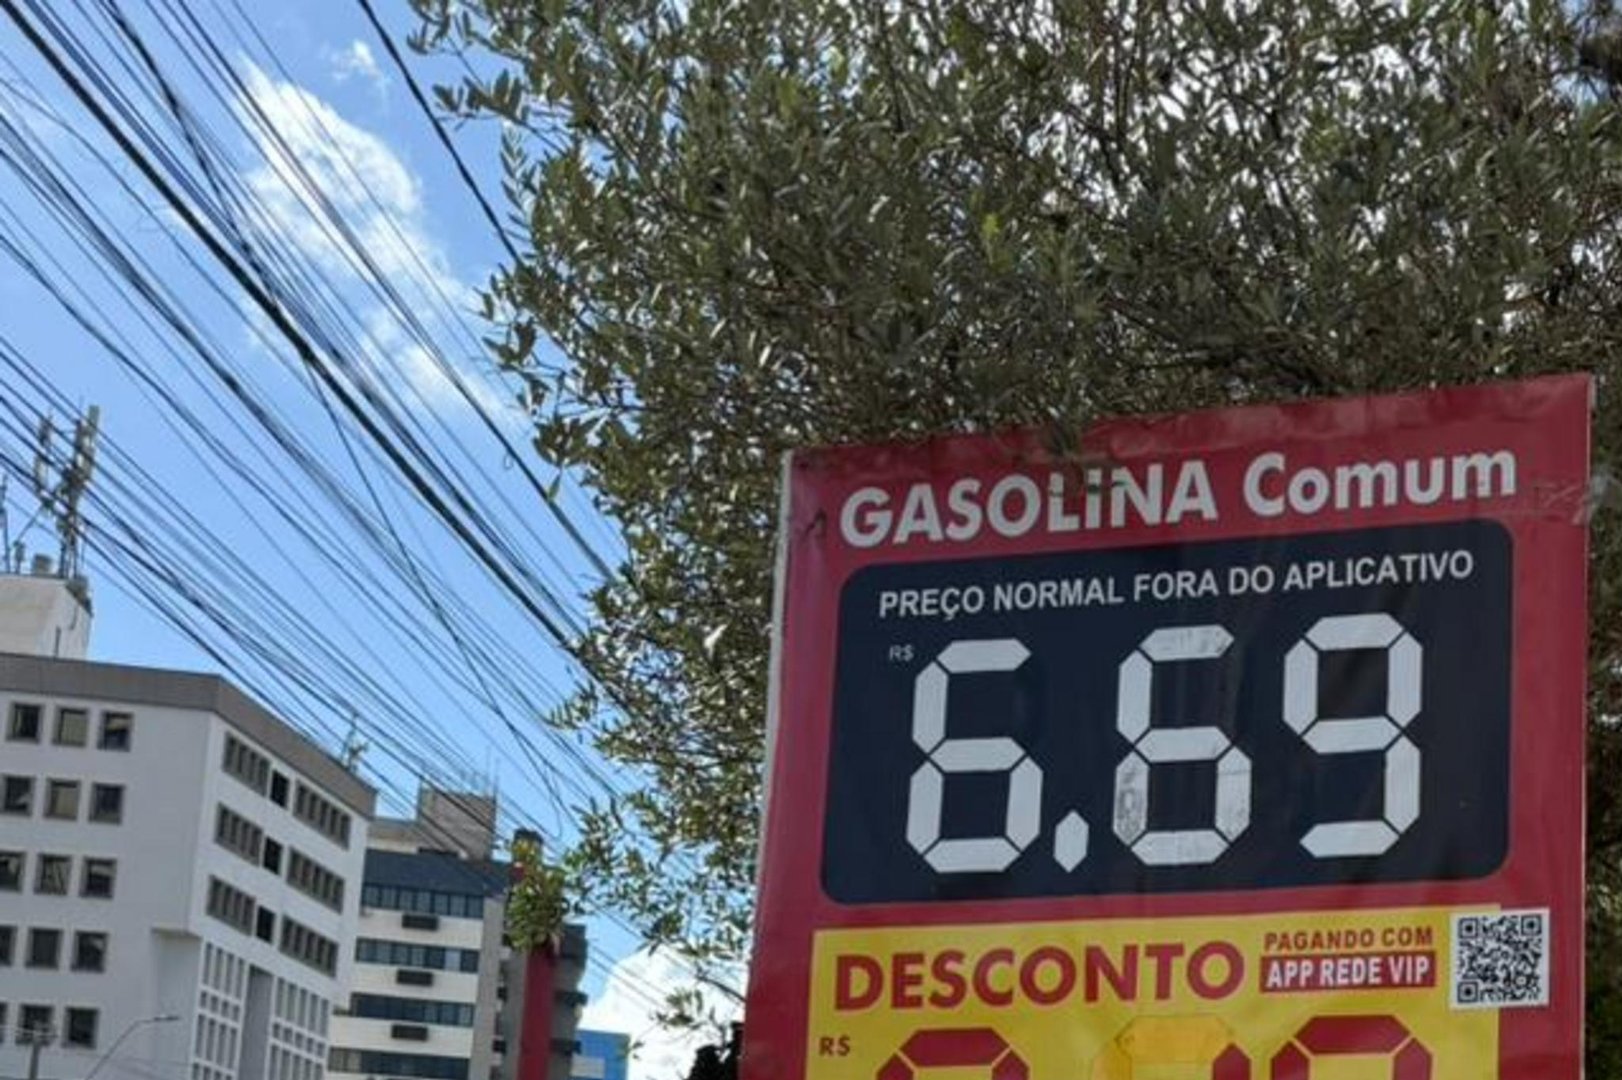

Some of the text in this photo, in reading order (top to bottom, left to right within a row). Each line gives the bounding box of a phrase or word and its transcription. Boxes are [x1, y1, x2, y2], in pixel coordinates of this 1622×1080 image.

[1244, 450, 1516, 516] Comum
[880, 551, 1474, 620] PREÇO NORMAL FORA DO APLICATIVO
[889, 644, 914, 662] R$
[1264, 926, 1433, 950] PAGANDO COM
[833, 940, 1246, 1012] DESCONTO
[1266, 955, 1430, 988] APP REDE VIP
[819, 1034, 851, 1057] R$
